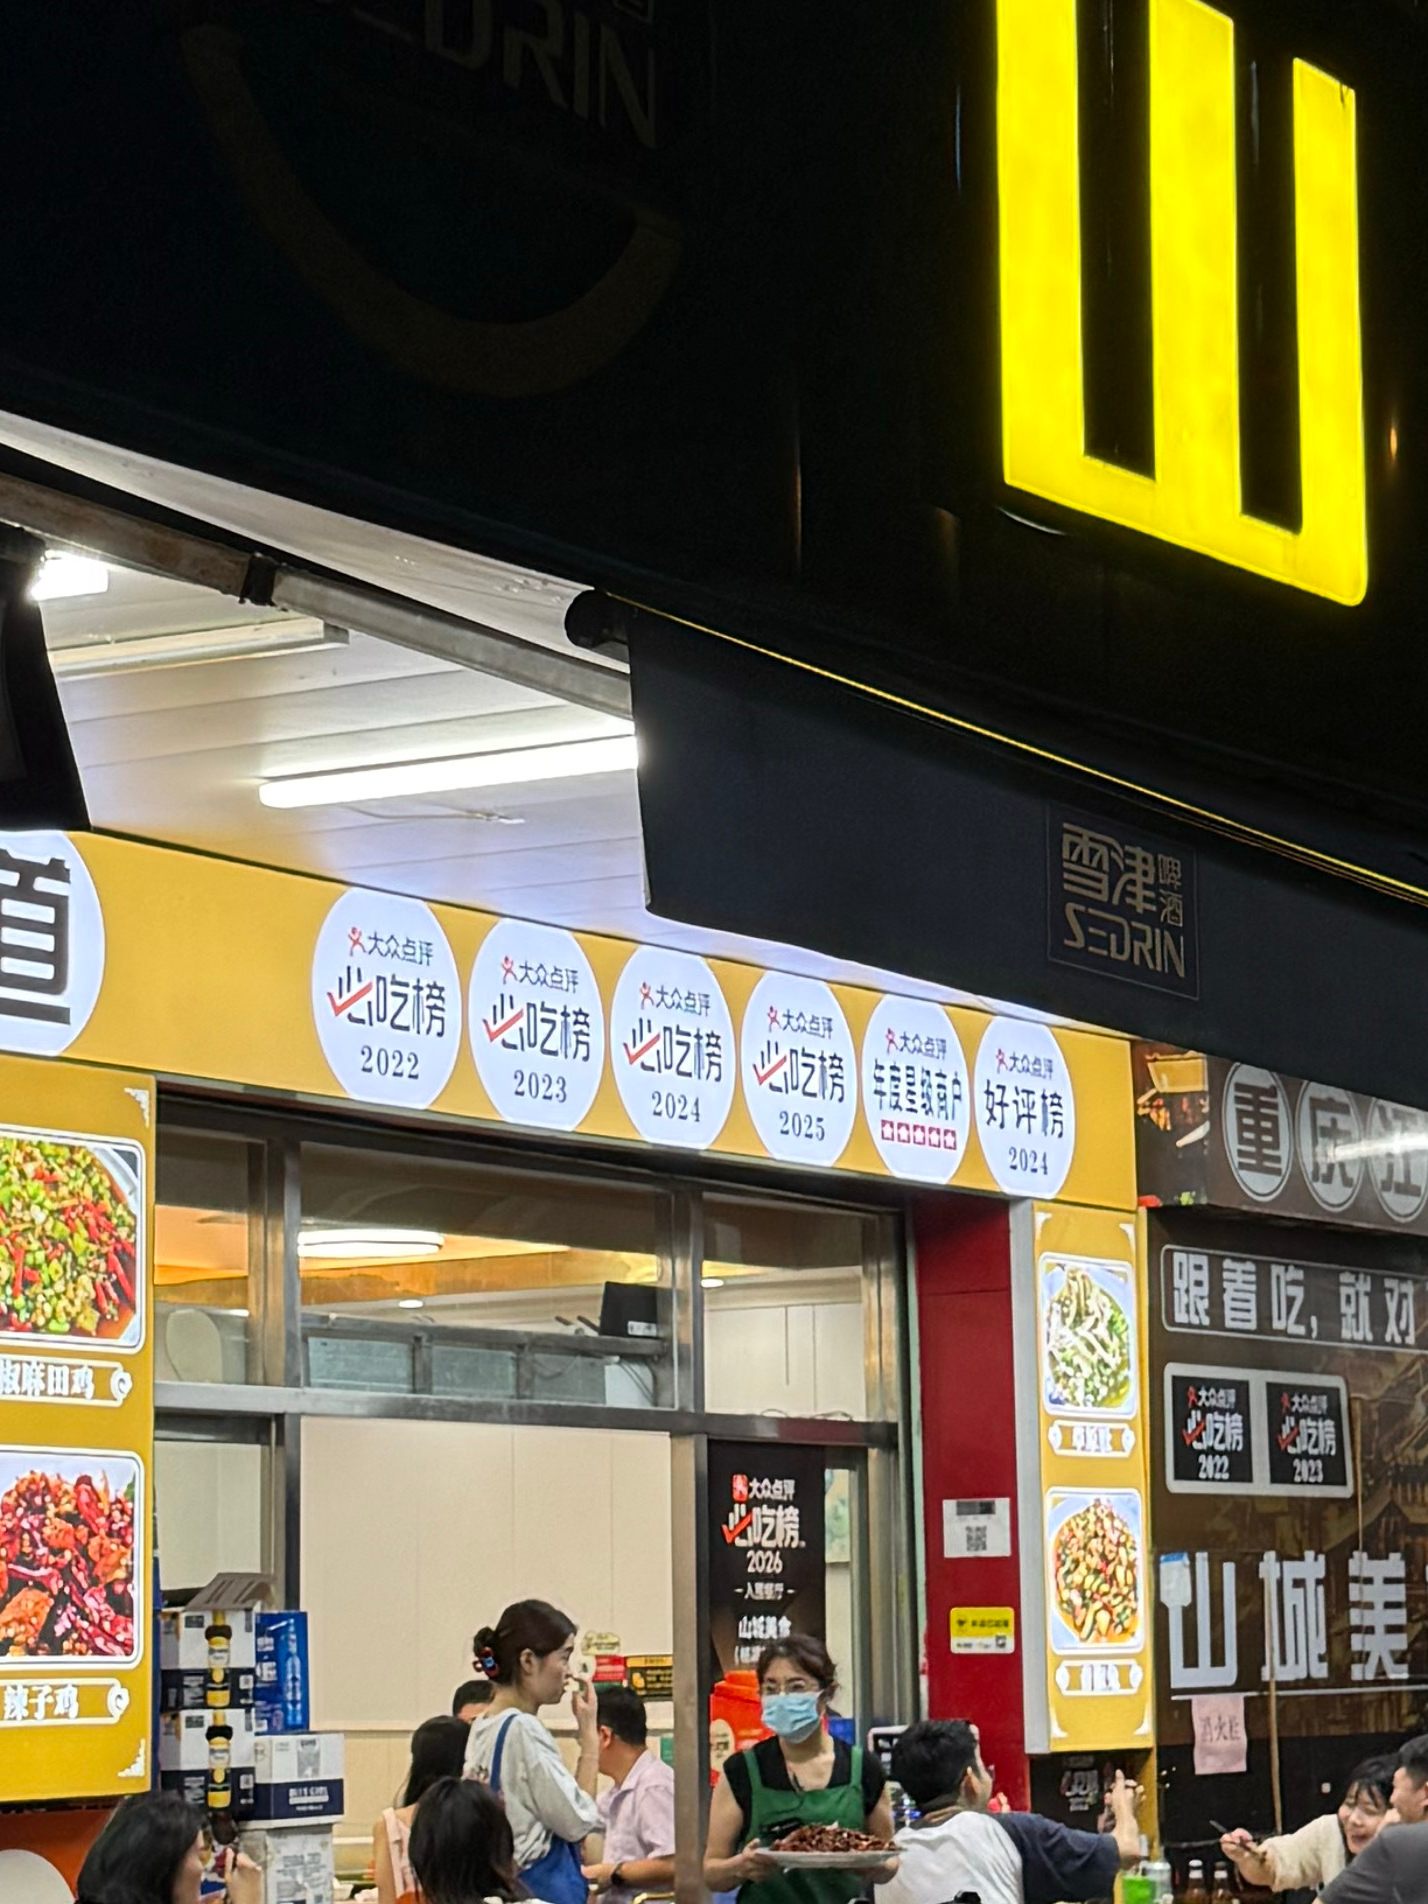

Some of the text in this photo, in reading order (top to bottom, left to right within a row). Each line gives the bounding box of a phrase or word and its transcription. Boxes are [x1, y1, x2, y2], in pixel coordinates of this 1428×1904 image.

[1062, 822, 1157, 914] 雪津
[367, 930, 433, 966] 大众点评
[1063, 902, 1185, 978] SEDRIN
[519, 960, 579, 993] 大众点评
[327, 965, 445, 1037] 必吃榜
[656, 985, 710, 1016] 大众点评
[482, 993, 590, 1062] 必吃榜
[782, 1009, 833, 1039] 大众点评
[361, 1045, 419, 1079] 2022
[623, 1018, 722, 1082] 必吃榜
[899, 1031, 947, 1060] 大众点评
[752, 1040, 844, 1103] 必吃榜
[1009, 1052, 1053, 1079] 大众点评
[513, 1070, 567, 1103] 2023
[652, 1091, 700, 1122] 2024
[984, 1079, 1064, 1138] 好评榜
[779, 1111, 825, 1141] 2025
[1008, 1147, 1048, 1175] 2024
[747, 1550, 783, 1573] 2026
